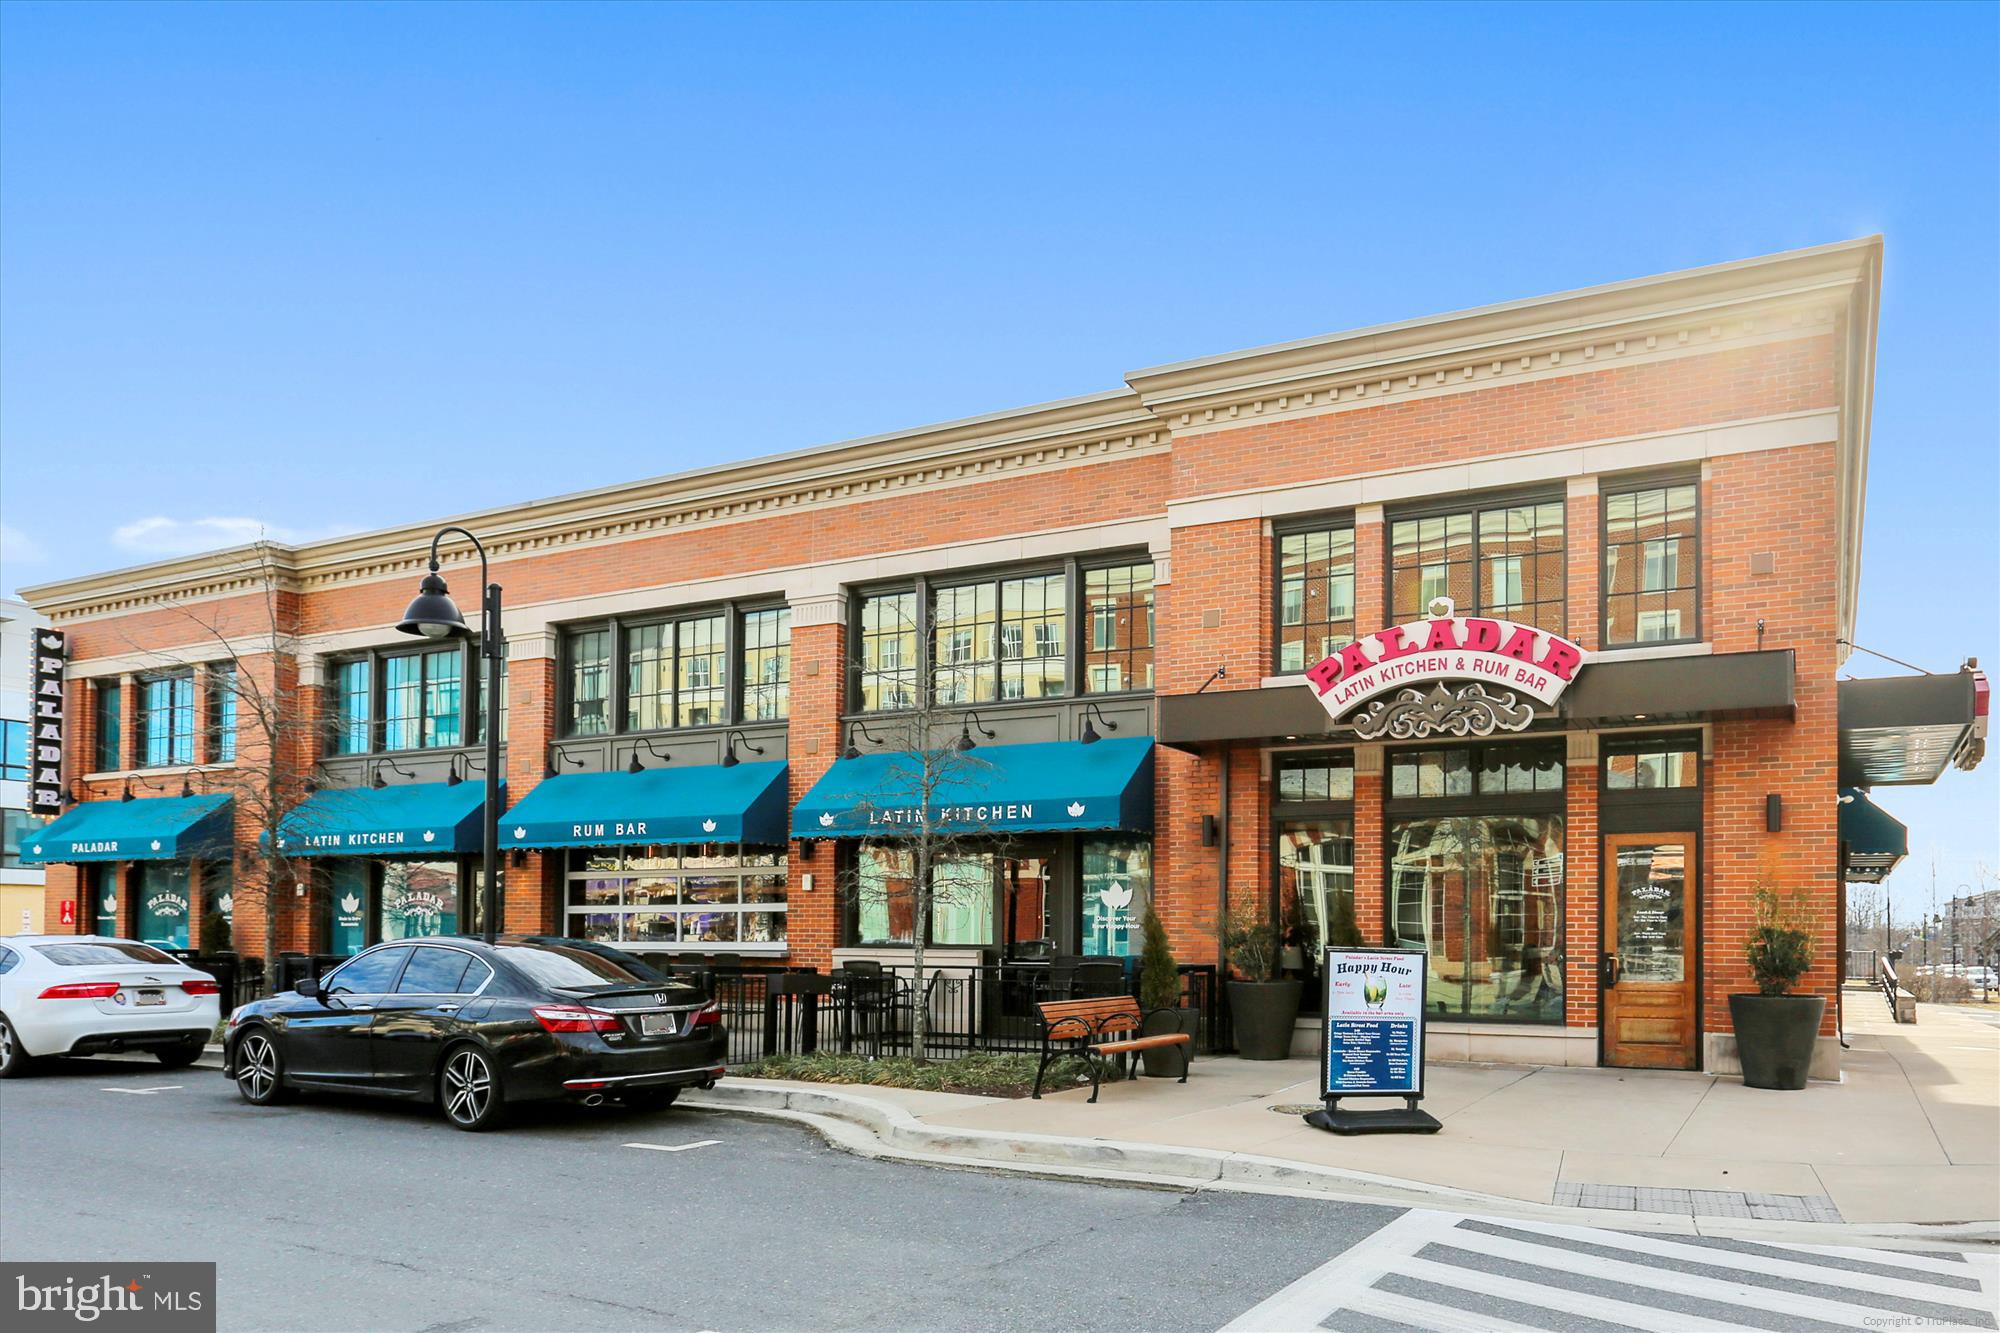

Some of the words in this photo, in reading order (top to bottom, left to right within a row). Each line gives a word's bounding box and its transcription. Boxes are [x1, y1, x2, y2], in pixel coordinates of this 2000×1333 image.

[1305, 618, 1582, 697] PALADAR
[1334, 674, 1375, 705] LATIN
[1380, 657, 1449, 683] KITCHEN
[1455, 657, 1465, 670] &
[1473, 657, 1510, 679] RUM
[1514, 668, 1548, 693] BAR
[36, 657, 64, 806] PALADAR
[869, 808, 924, 825] LATIN
[940, 803, 1033, 823] KITCHEN
[573, 824, 604, 837] RUM
[615, 822, 647, 836] BAR
[71, 841, 118, 854] PALADAR
[305, 834, 340, 847] LATIN
[348, 832, 404, 846] KITCHEN
[146, 892, 189, 910] PALADAR
[395, 891, 444, 911] PALADAR
[1337, 963, 1378, 974] Happy
[1380, 962, 1412, 975] Hour
